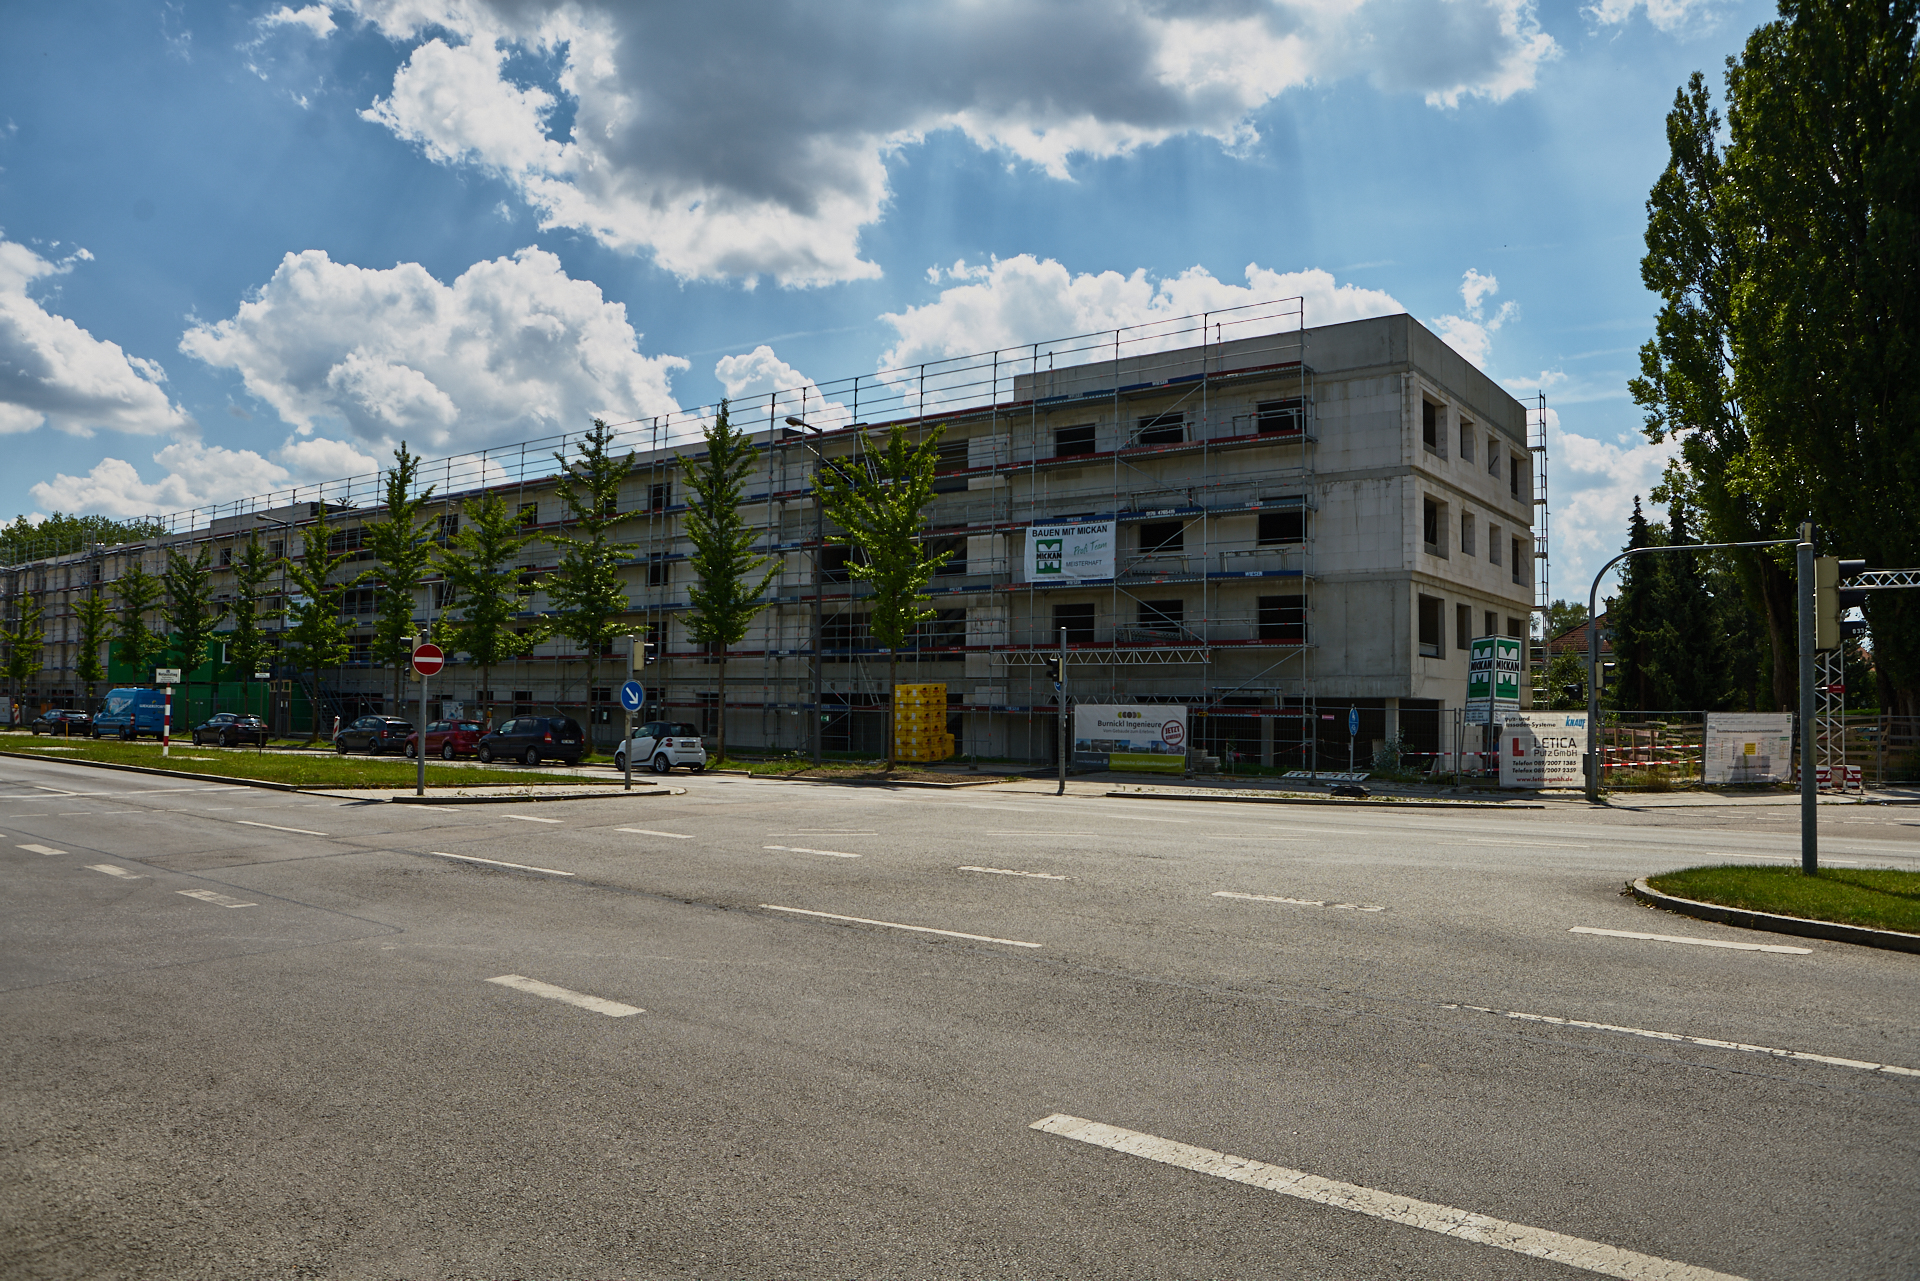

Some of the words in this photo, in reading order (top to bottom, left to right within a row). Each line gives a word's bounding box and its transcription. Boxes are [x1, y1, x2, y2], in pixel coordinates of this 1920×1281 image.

[1032, 529, 1059, 537] BAUEN
[1062, 527, 1075, 536] MIT
[1077, 525, 1107, 534] MICKAN
[1073, 545, 1088, 556] Profi
[1089, 539, 1108, 549] Team
[1036, 552, 1062, 560] MICKAN
[1066, 559, 1102, 568] MEISTERHAFT
[1471, 660, 1493, 671] MICKAN
[1496, 660, 1519, 672] MICKAN
[1126, 720, 1162, 729] Ingenieure
[1506, 721, 1556, 729] assaden-Systeme
[1165, 726, 1180, 734] JETZT
[1534, 737, 1577, 748] LETICA
